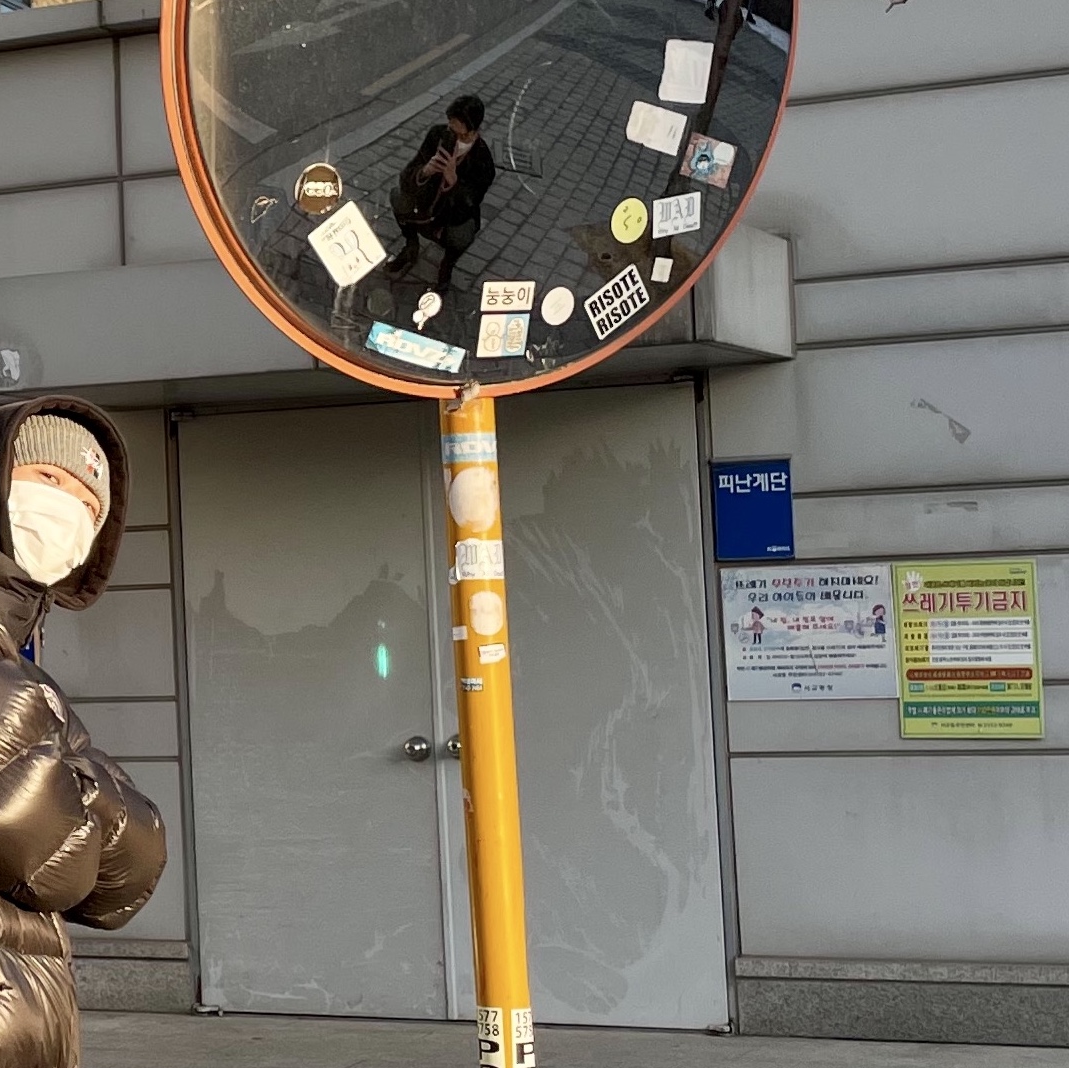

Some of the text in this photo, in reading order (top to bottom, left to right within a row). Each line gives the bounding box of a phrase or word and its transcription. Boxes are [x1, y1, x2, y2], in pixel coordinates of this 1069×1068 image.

[486, 286, 531, 305] 눙눙이
[588, 268, 639, 318] RISOTE
[596, 286, 646, 336] RISOTE
[718, 472, 788, 493] 피난계단
[902, 590, 1027, 613] 쓰레기투기금지
